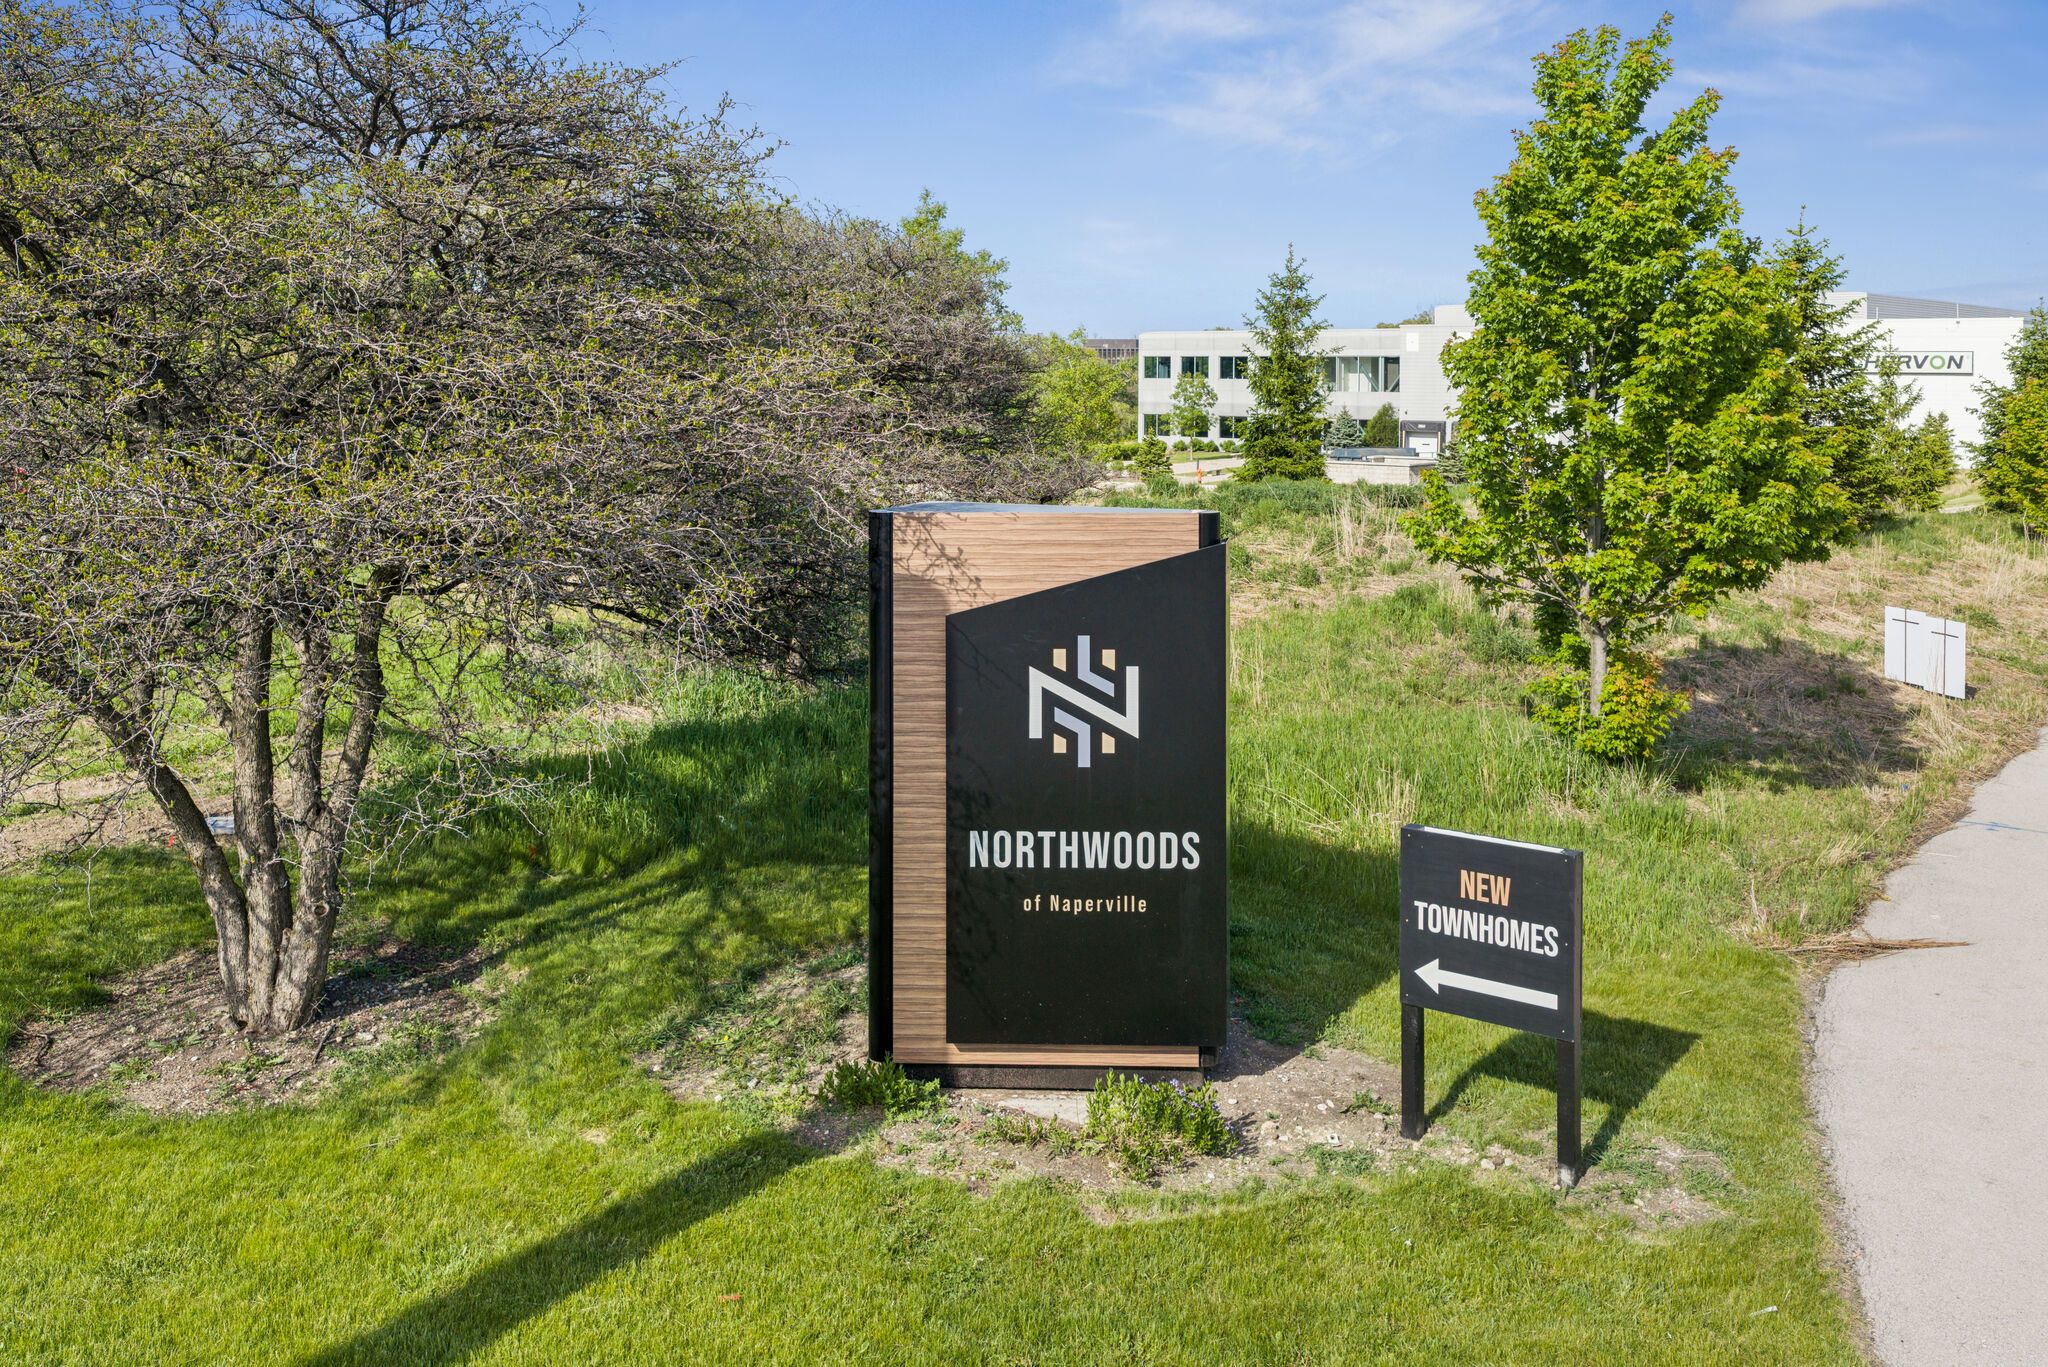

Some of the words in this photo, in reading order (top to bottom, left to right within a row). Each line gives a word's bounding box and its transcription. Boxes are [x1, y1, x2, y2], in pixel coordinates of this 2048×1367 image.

[969, 830, 1200, 870] NORTHWOODS
[1023, 895, 1041, 912] of
[1050, 895, 1147, 915] Naperville
[1460, 869, 1511, 907] NEW
[1414, 900, 1559, 957] TOWNHOMES
